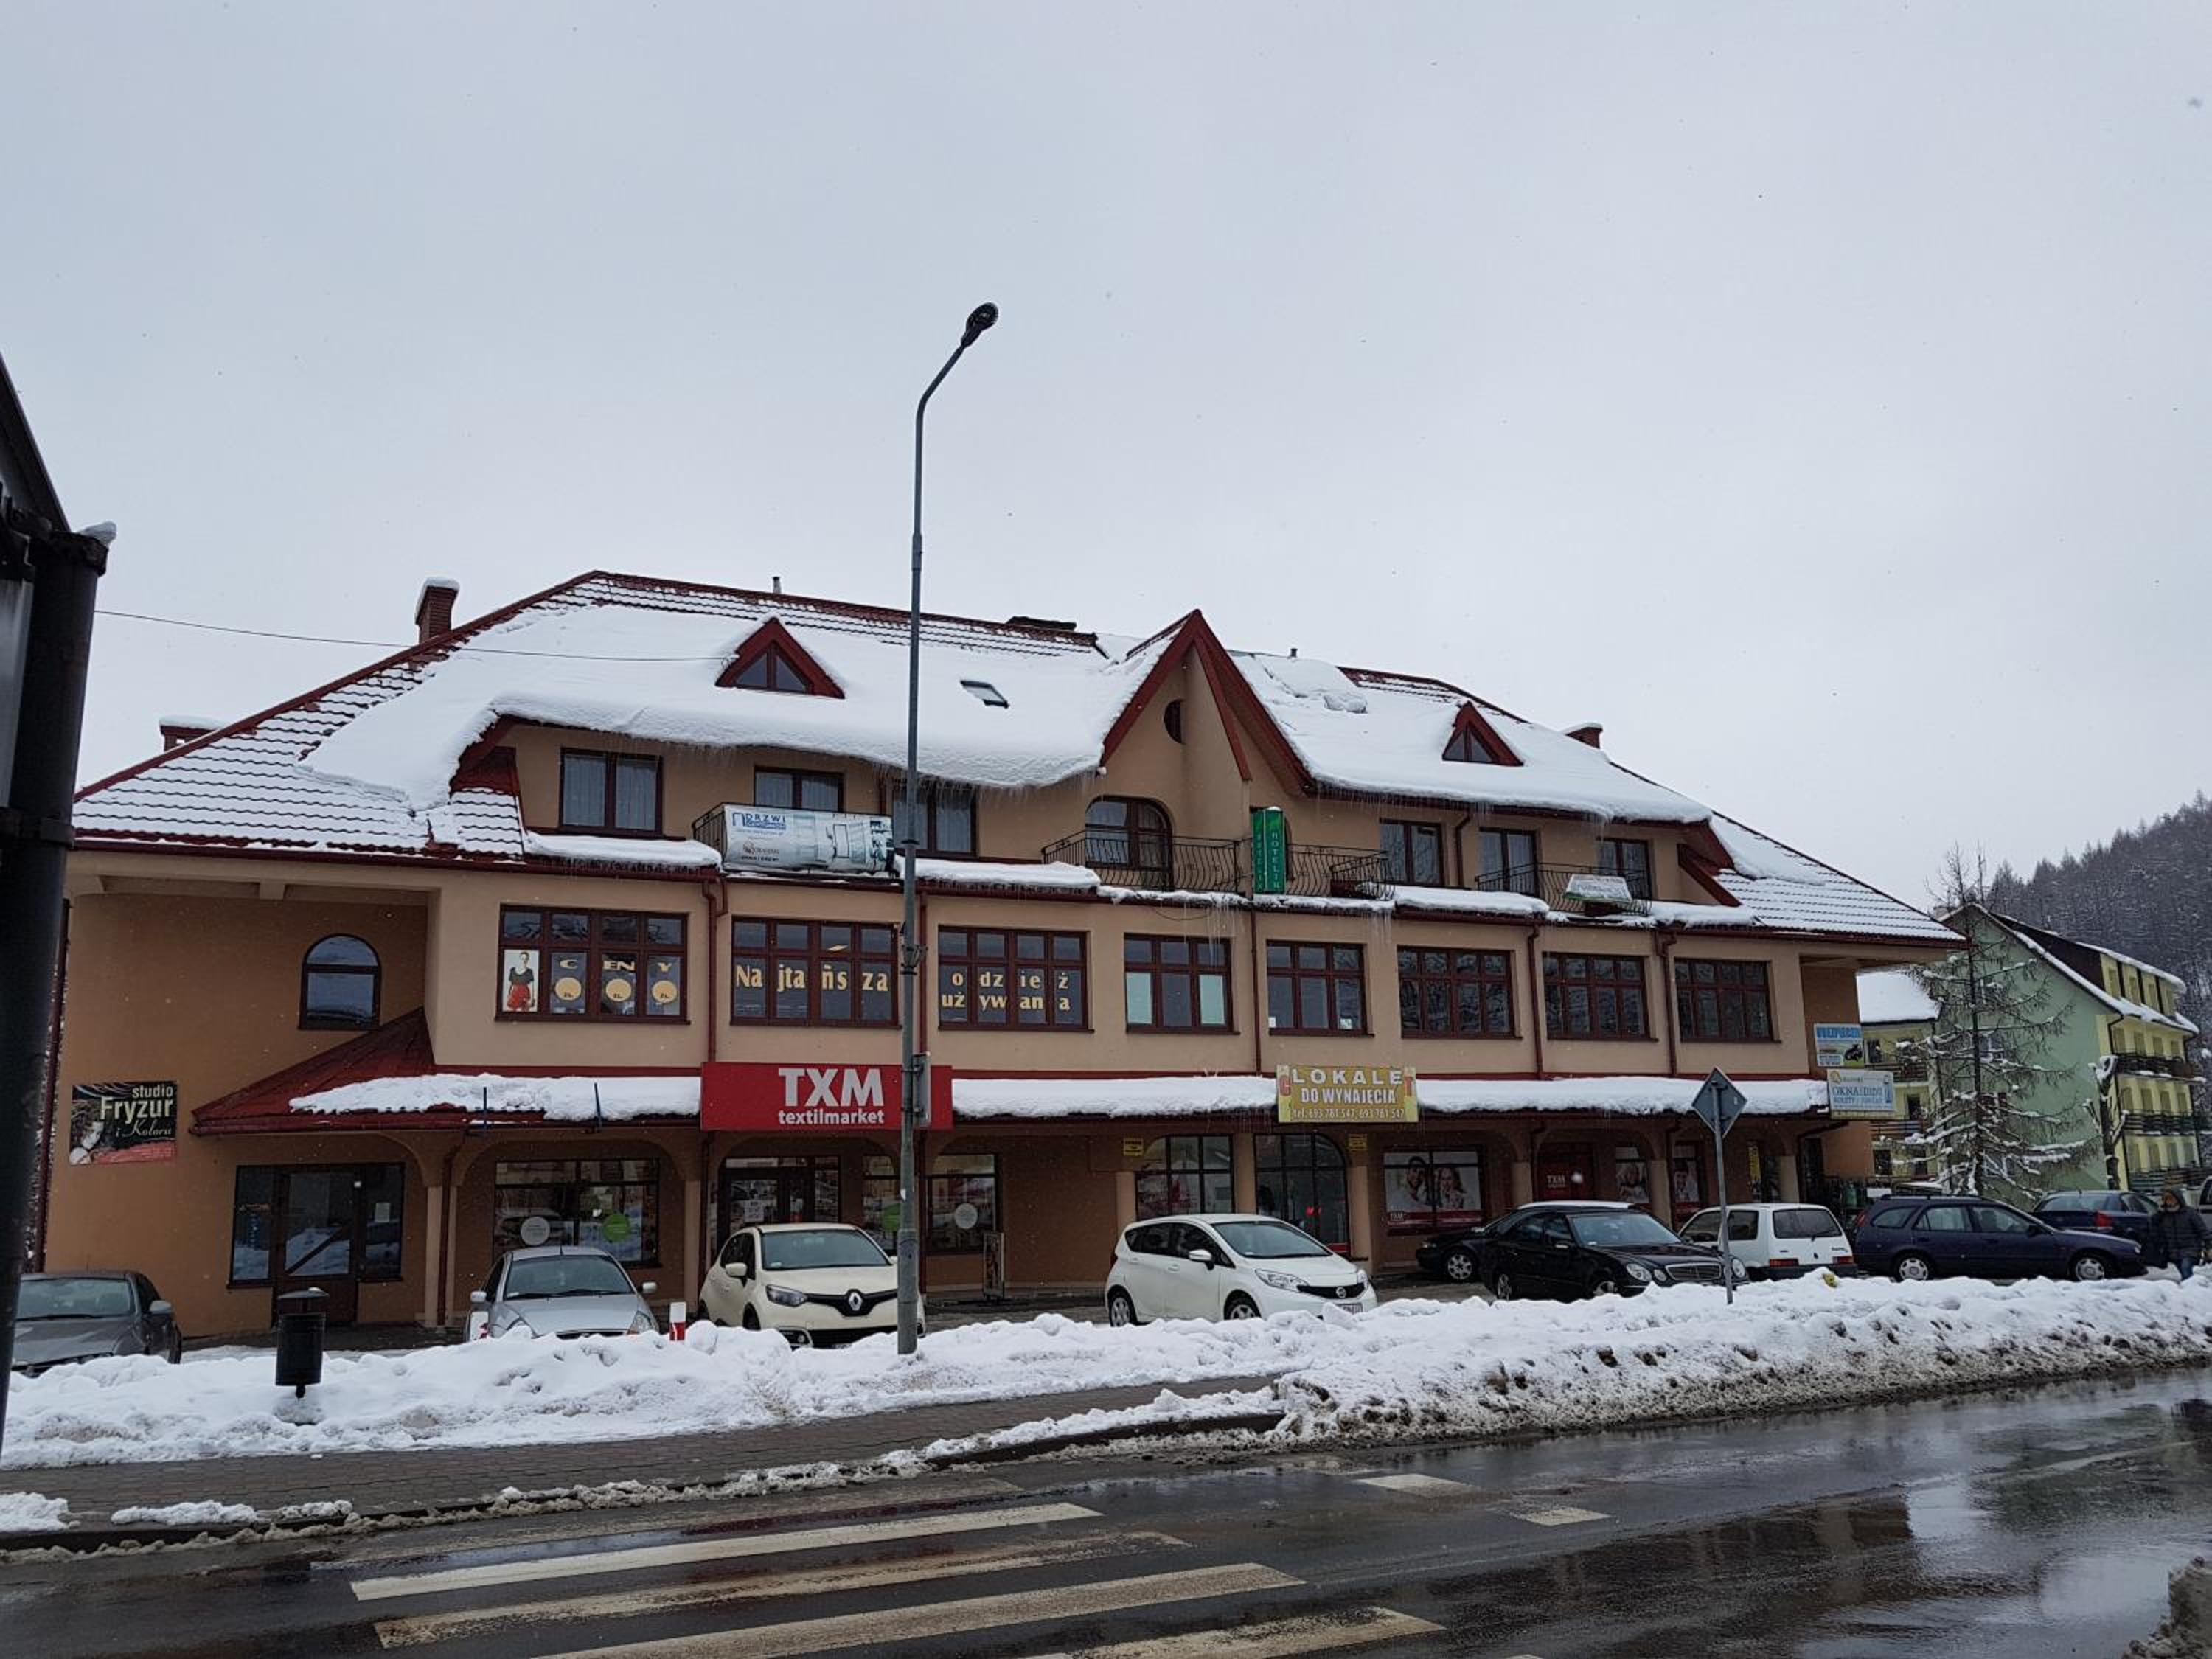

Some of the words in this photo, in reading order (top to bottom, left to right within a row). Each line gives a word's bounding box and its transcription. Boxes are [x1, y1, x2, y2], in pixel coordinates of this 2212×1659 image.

[1292, 1068, 1403, 1085] LOKALE
[132, 1085, 174, 1098] studio
[778, 1068, 884, 1107] TXM
[1301, 1088, 1318, 1104] DO
[100, 1096, 174, 1124] Fryzur
[778, 1108, 885, 1125] textilmarket
